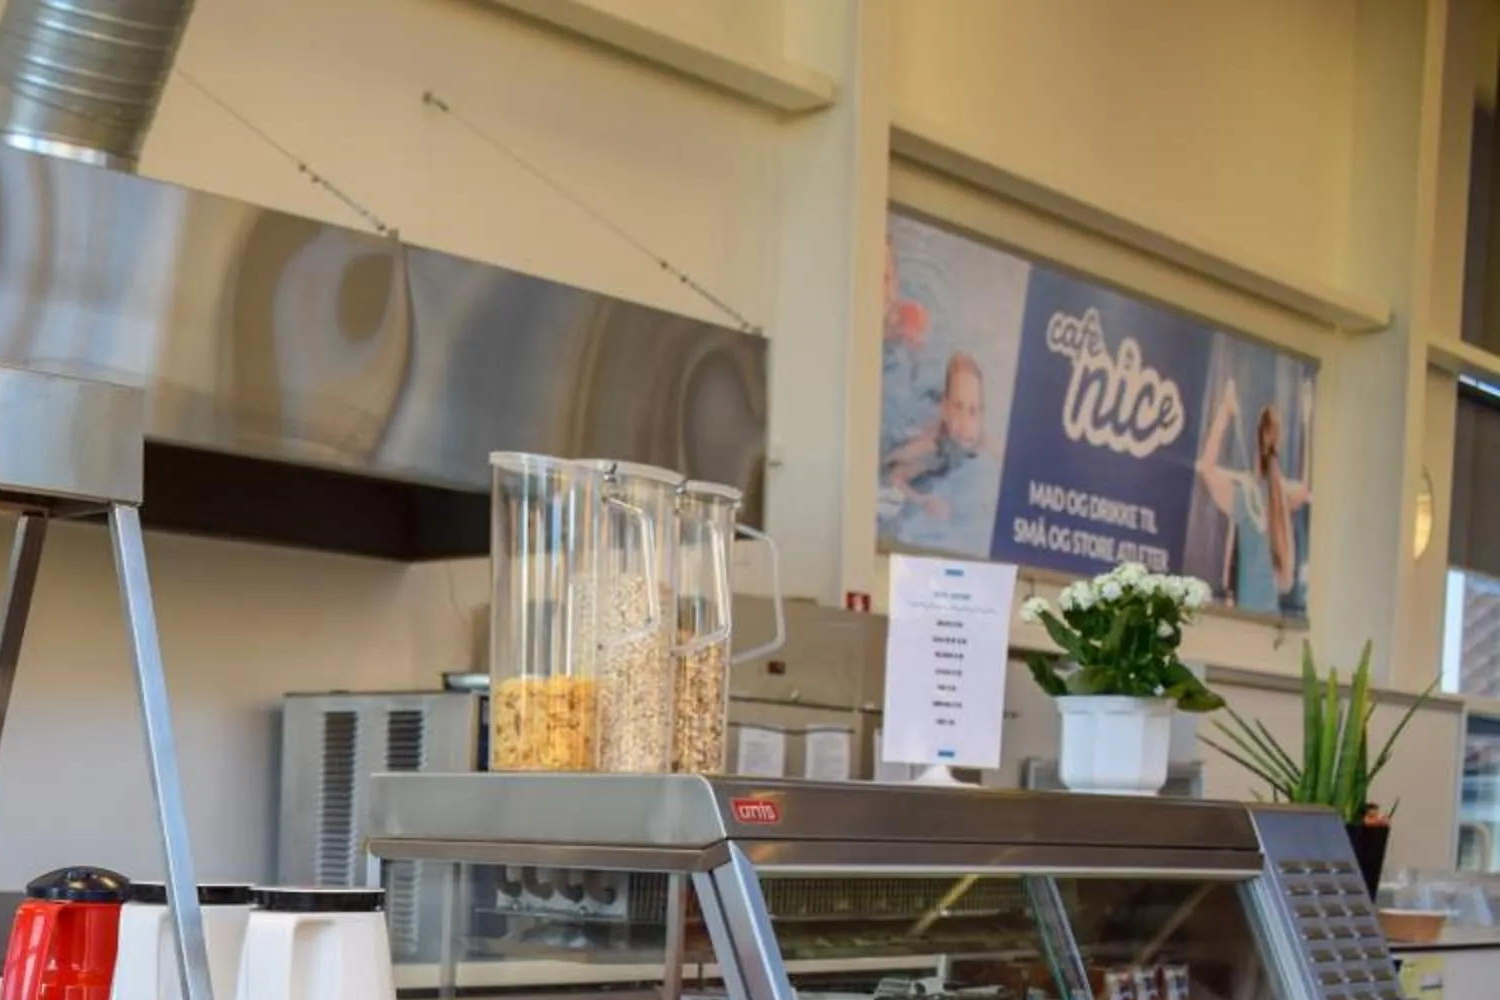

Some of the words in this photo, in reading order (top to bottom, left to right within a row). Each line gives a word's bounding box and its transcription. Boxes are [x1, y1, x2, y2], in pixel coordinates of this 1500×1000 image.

[1067, 343, 1182, 449] nice
[1028, 480, 1064, 512] MAD
[1066, 489, 1088, 517] OG
[1140, 507, 1157, 533] TIL
[1013, 517, 1046, 547] SMÅ
[1050, 525, 1071, 550] OG
[1072, 530, 1115, 562] STORE
